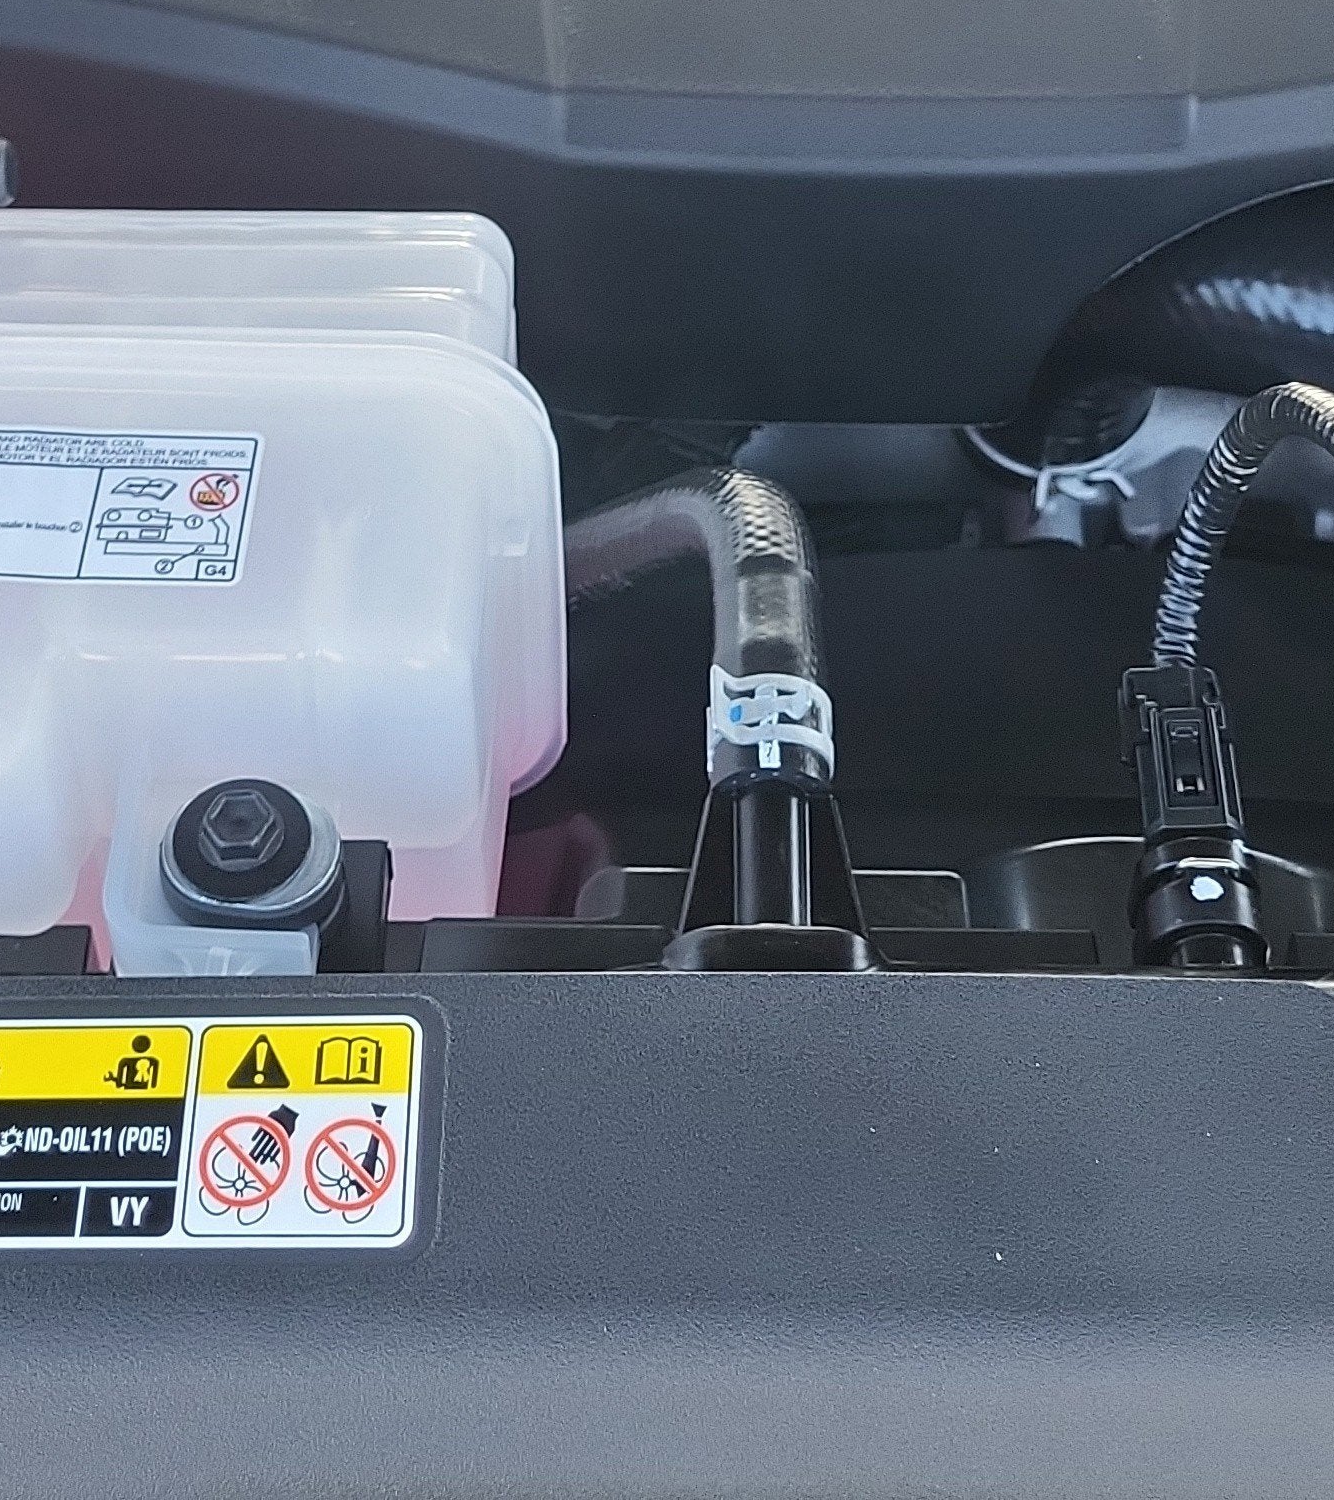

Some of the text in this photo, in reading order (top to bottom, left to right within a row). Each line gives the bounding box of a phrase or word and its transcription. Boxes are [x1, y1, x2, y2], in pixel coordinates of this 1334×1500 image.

[205, 564, 227, 576] G4
[23, 1126, 113, 1153] ND-OIL11
[118, 1126, 172, 1157] (POE)
[110, 1196, 149, 1227] VY
